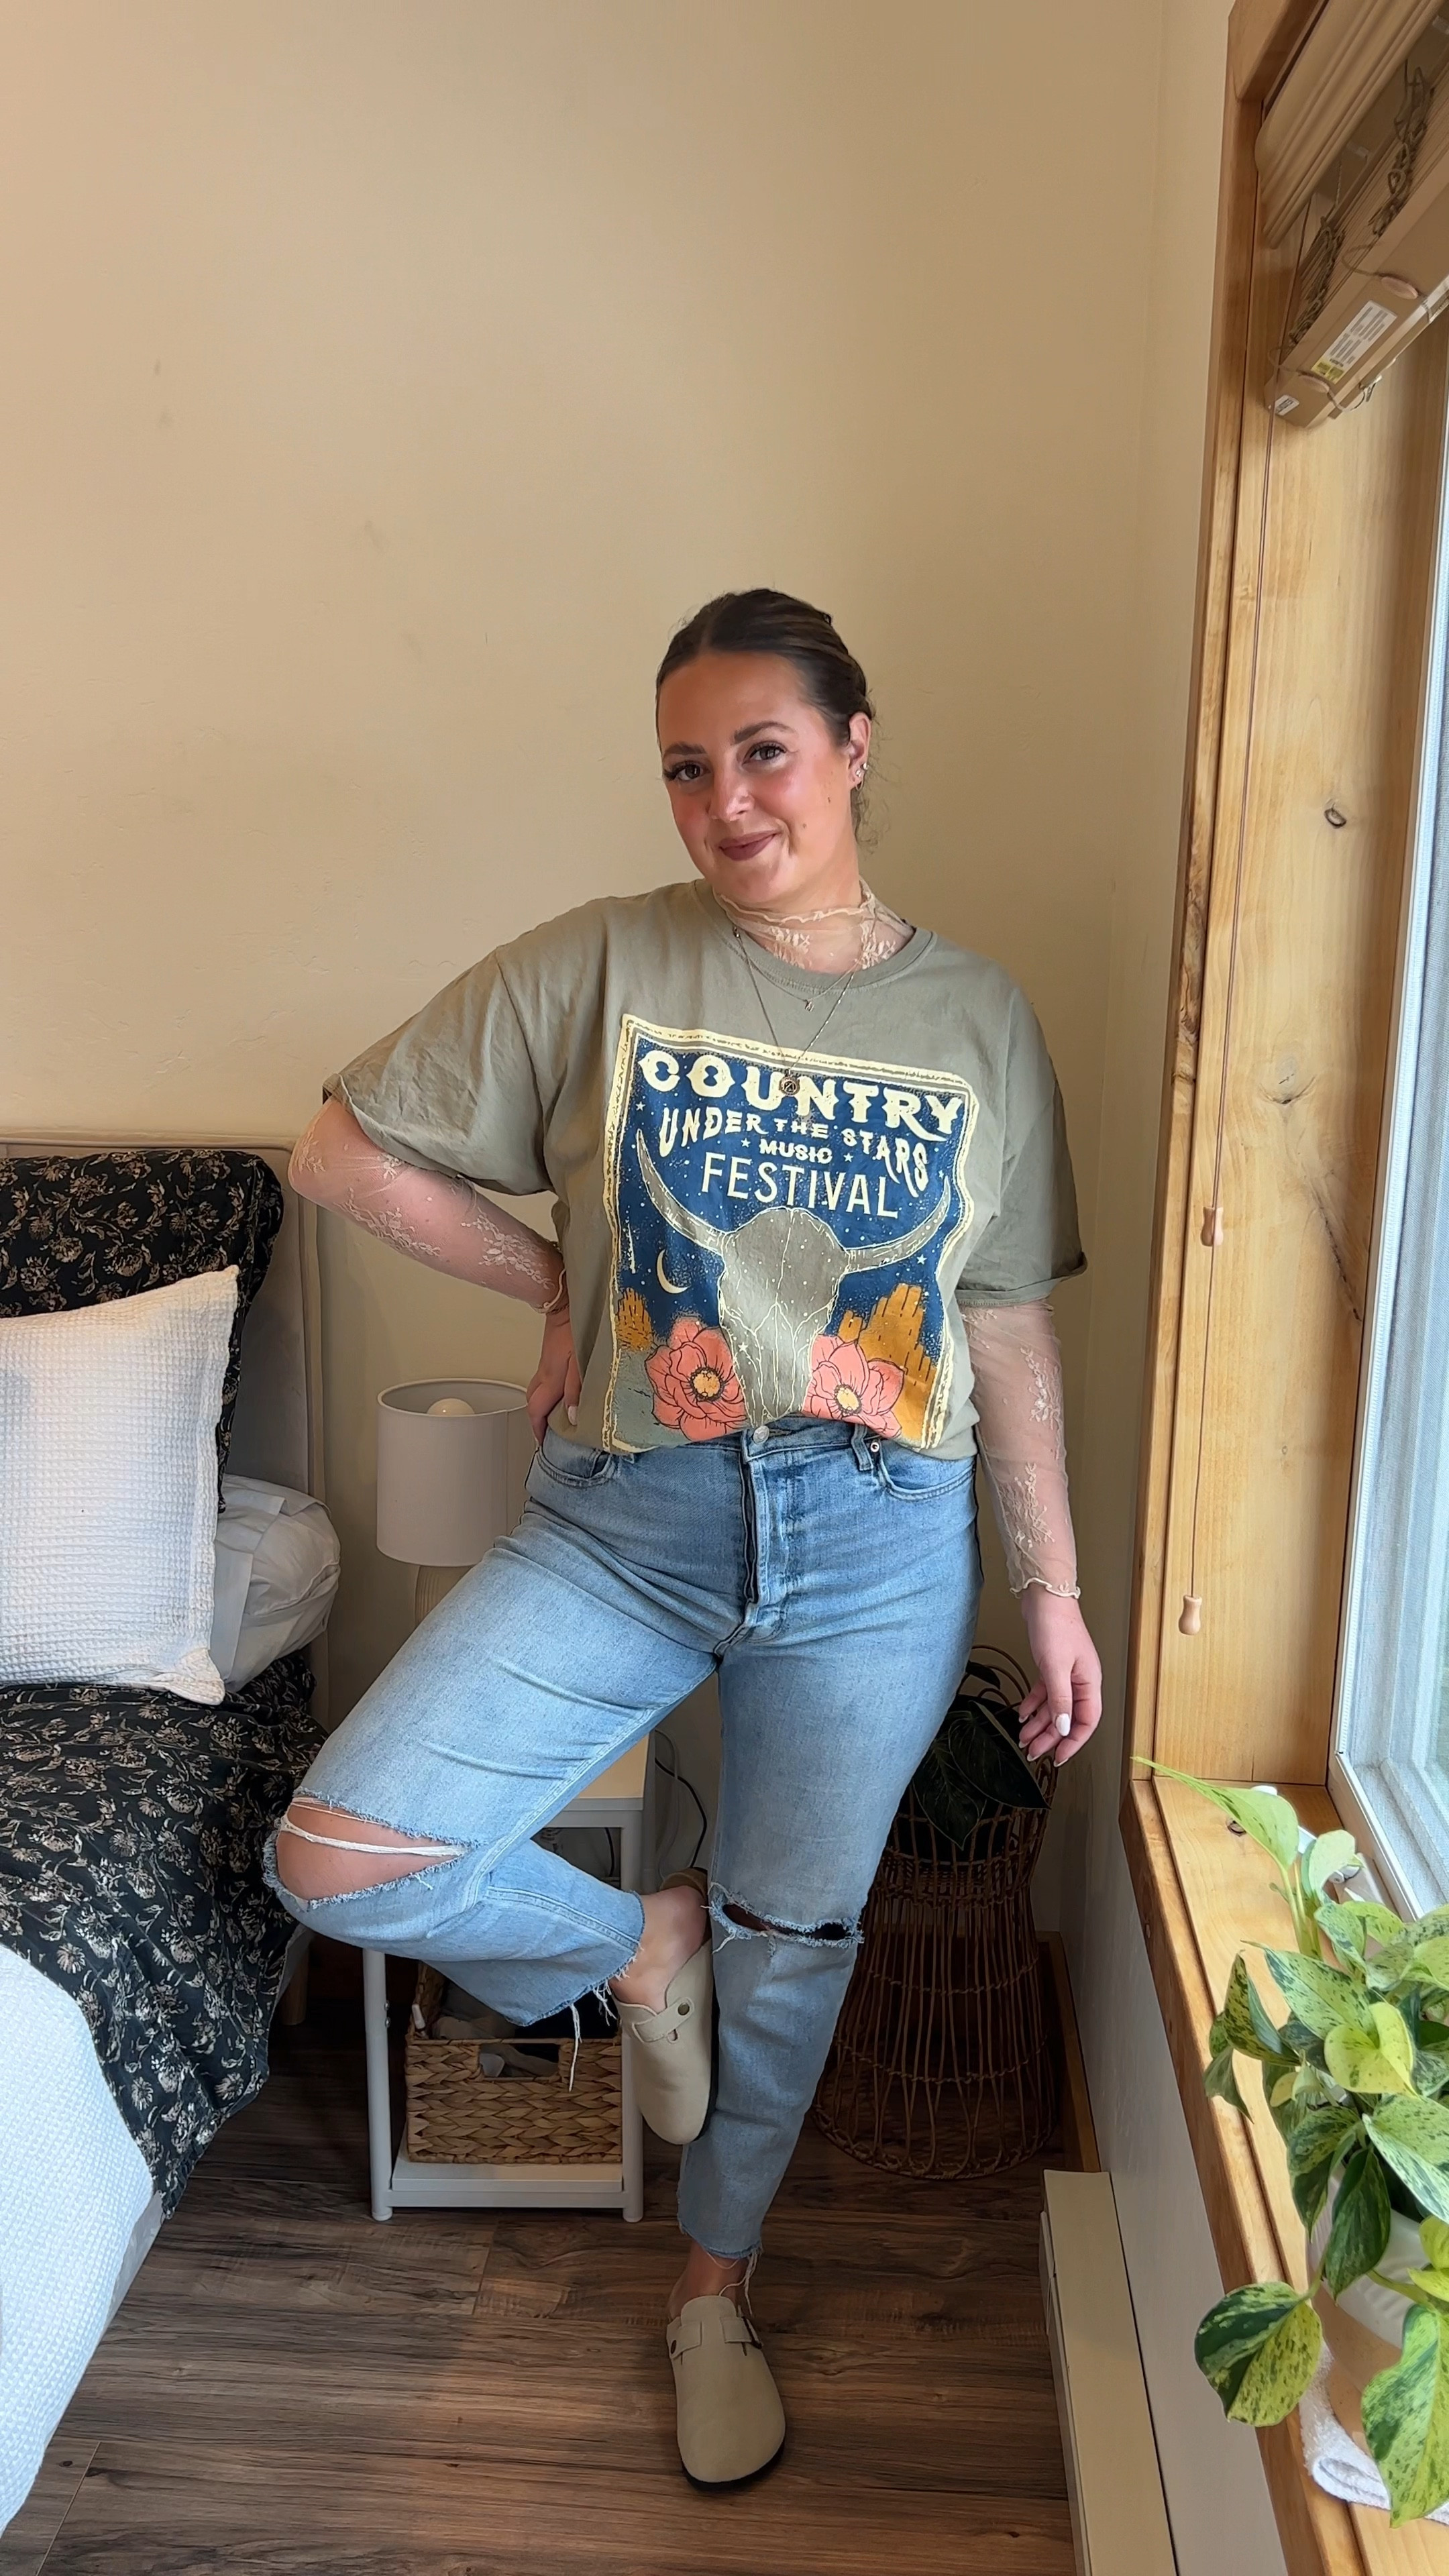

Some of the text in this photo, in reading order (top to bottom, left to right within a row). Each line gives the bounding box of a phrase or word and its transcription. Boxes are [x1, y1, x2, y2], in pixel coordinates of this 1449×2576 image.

[638, 1050, 963, 1142] COUNTRY
[659, 1106, 929, 1197] UNDER THE STARS
[702, 1152, 899, 1219] FESTIVAL
[759, 1138, 833, 1164] MUSIC
